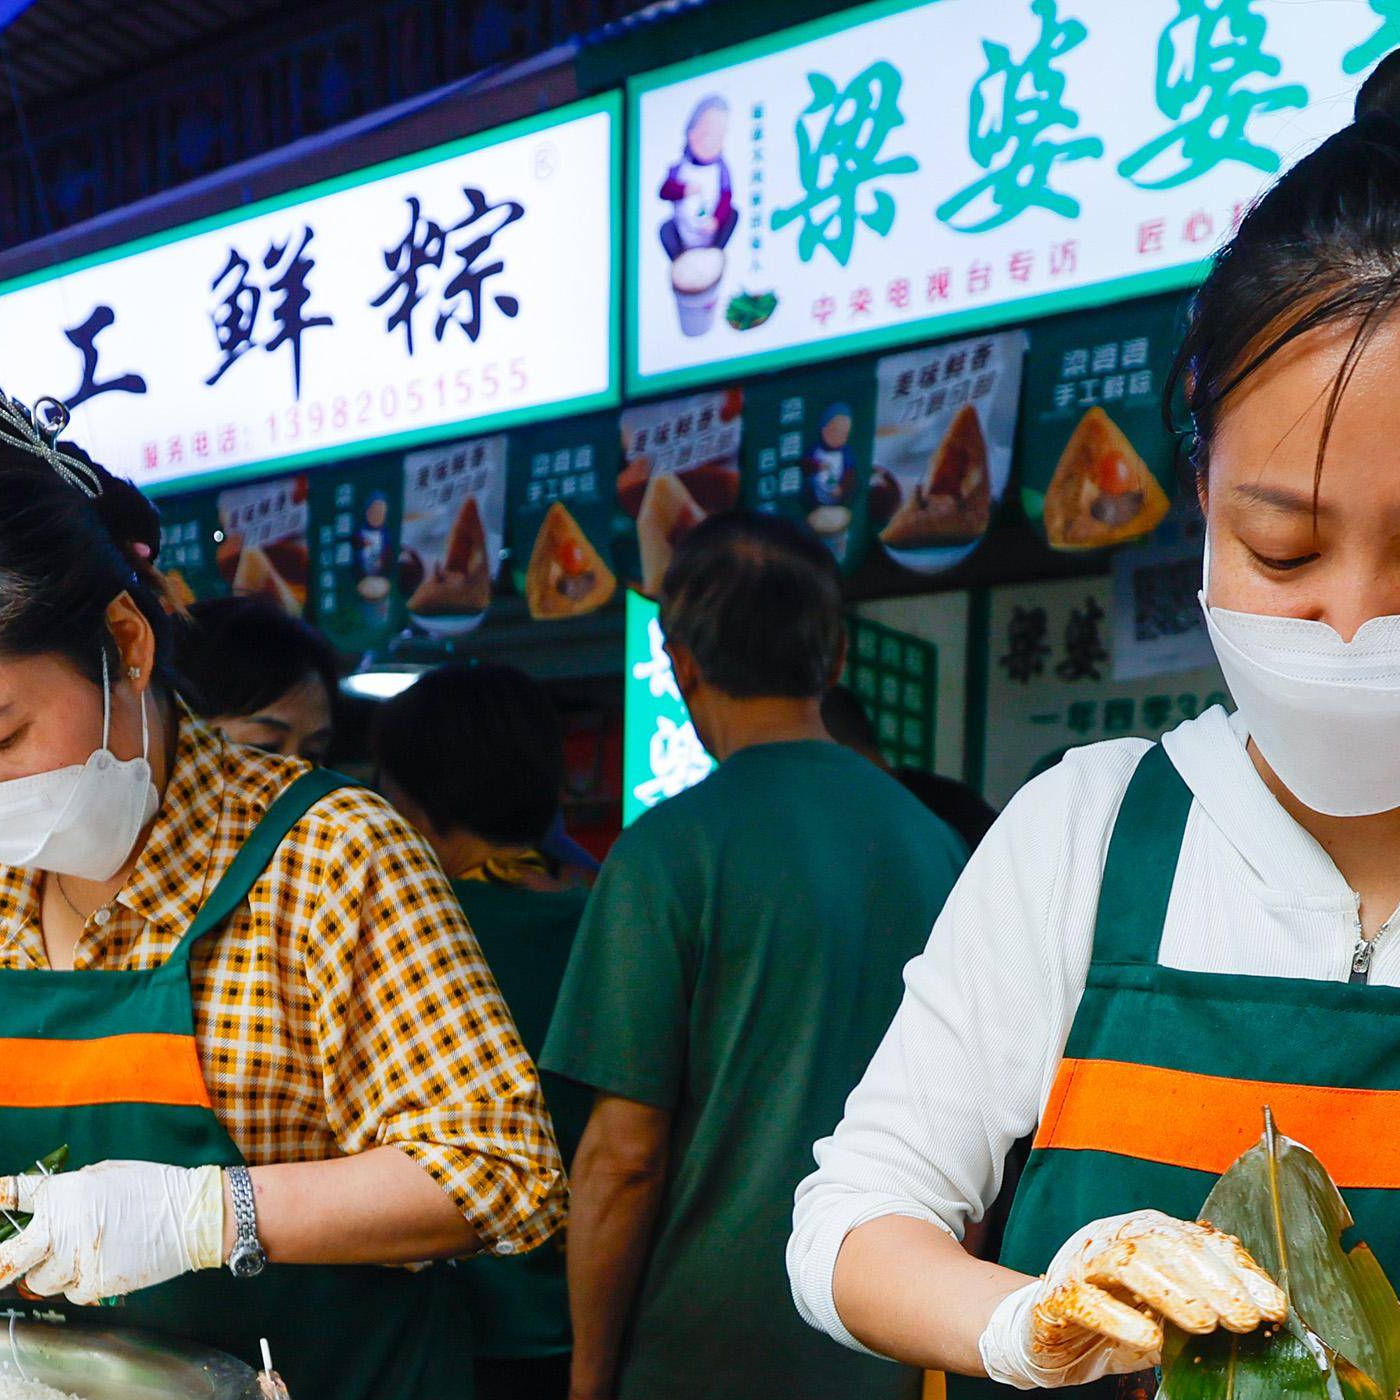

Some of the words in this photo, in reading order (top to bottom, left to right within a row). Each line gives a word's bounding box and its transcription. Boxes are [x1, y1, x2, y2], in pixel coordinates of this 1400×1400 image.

[811, 239, 1079, 326] 中央电视台专访
[1137, 196, 1260, 254] 匠心
[265, 356, 530, 444] 13982051555
